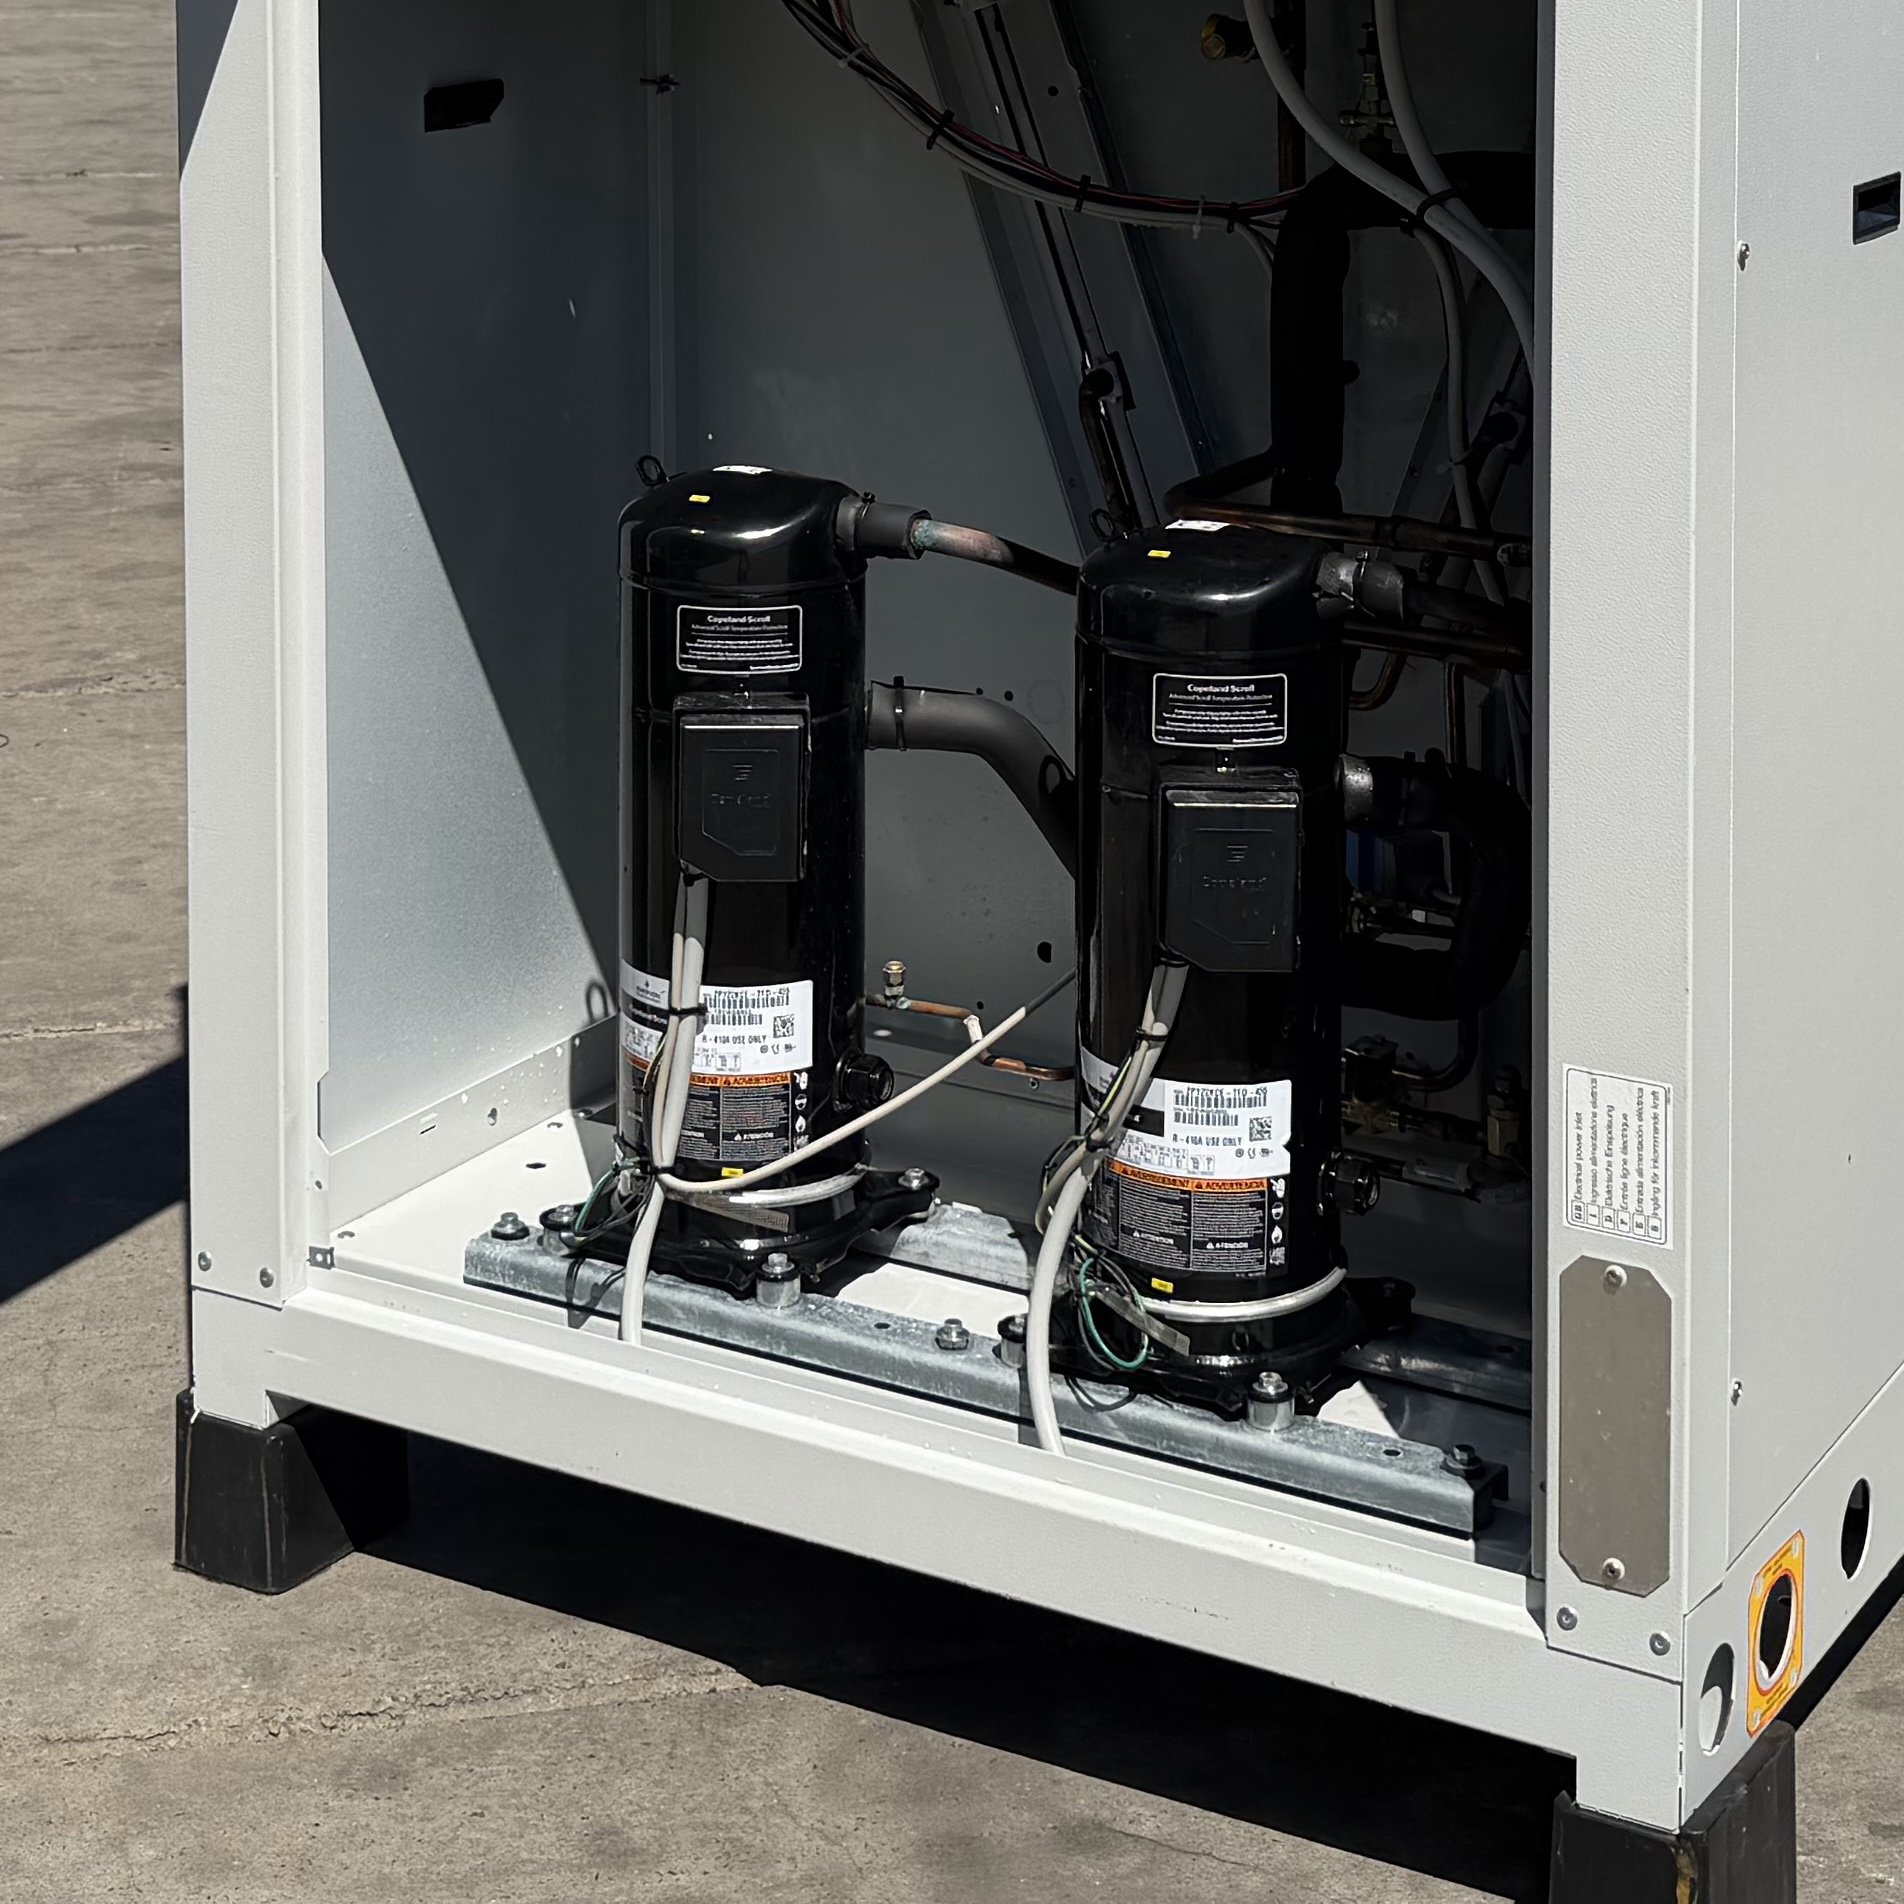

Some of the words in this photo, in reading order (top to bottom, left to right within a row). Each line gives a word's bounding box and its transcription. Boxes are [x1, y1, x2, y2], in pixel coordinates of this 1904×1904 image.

[706, 615, 746, 624] Copeland
[748, 615, 770, 623] Scroll
[1187, 684, 1229, 693] Copeland
[1230, 684, 1255, 692] Scroll
[1574, 1112, 1582, 1130] inlet
[1621, 1158, 1629, 1179] ligne
[1574, 1163, 1582, 1200] Electrical
